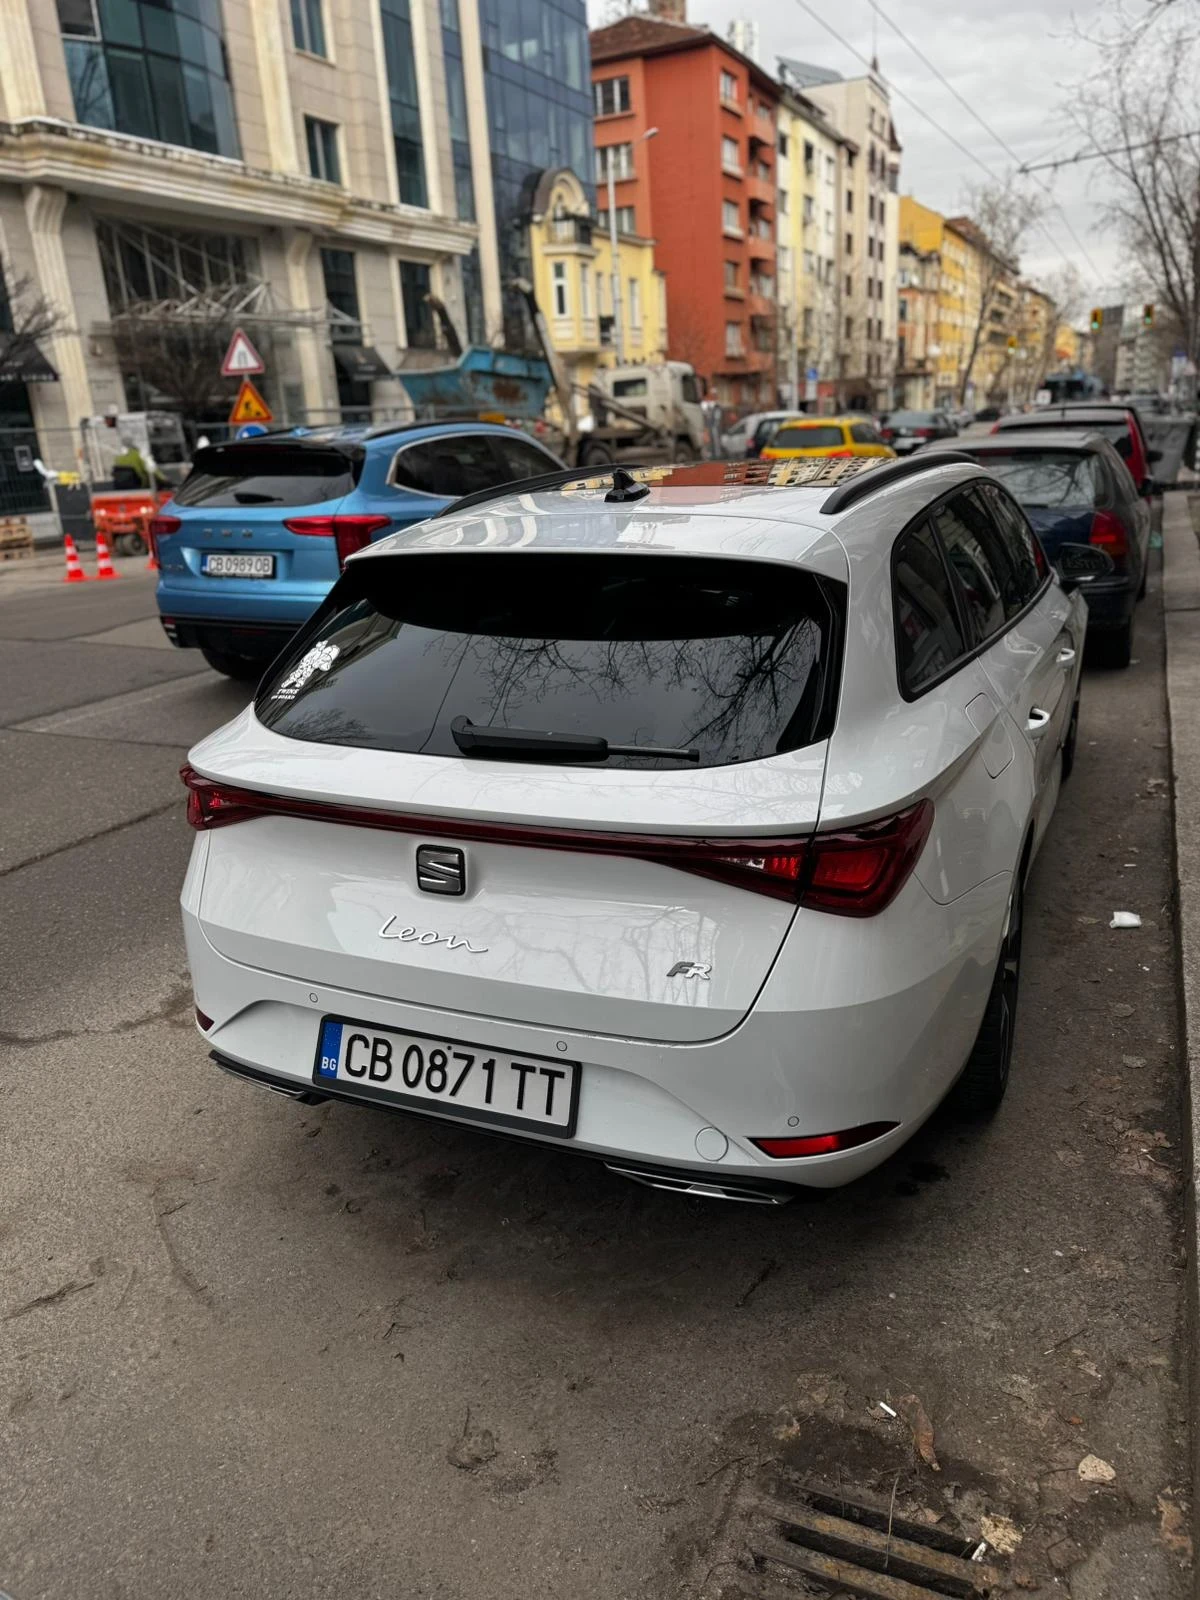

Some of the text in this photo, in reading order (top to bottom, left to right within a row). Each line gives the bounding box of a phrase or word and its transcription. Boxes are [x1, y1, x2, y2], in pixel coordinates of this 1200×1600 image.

[225, 557, 253, 572] 0989
[378, 915, 489, 953] Leon
[667, 961, 712, 980] FR
[321, 1056, 337, 1071] BG
[345, 1033, 566, 1116] CB 0871 TT
